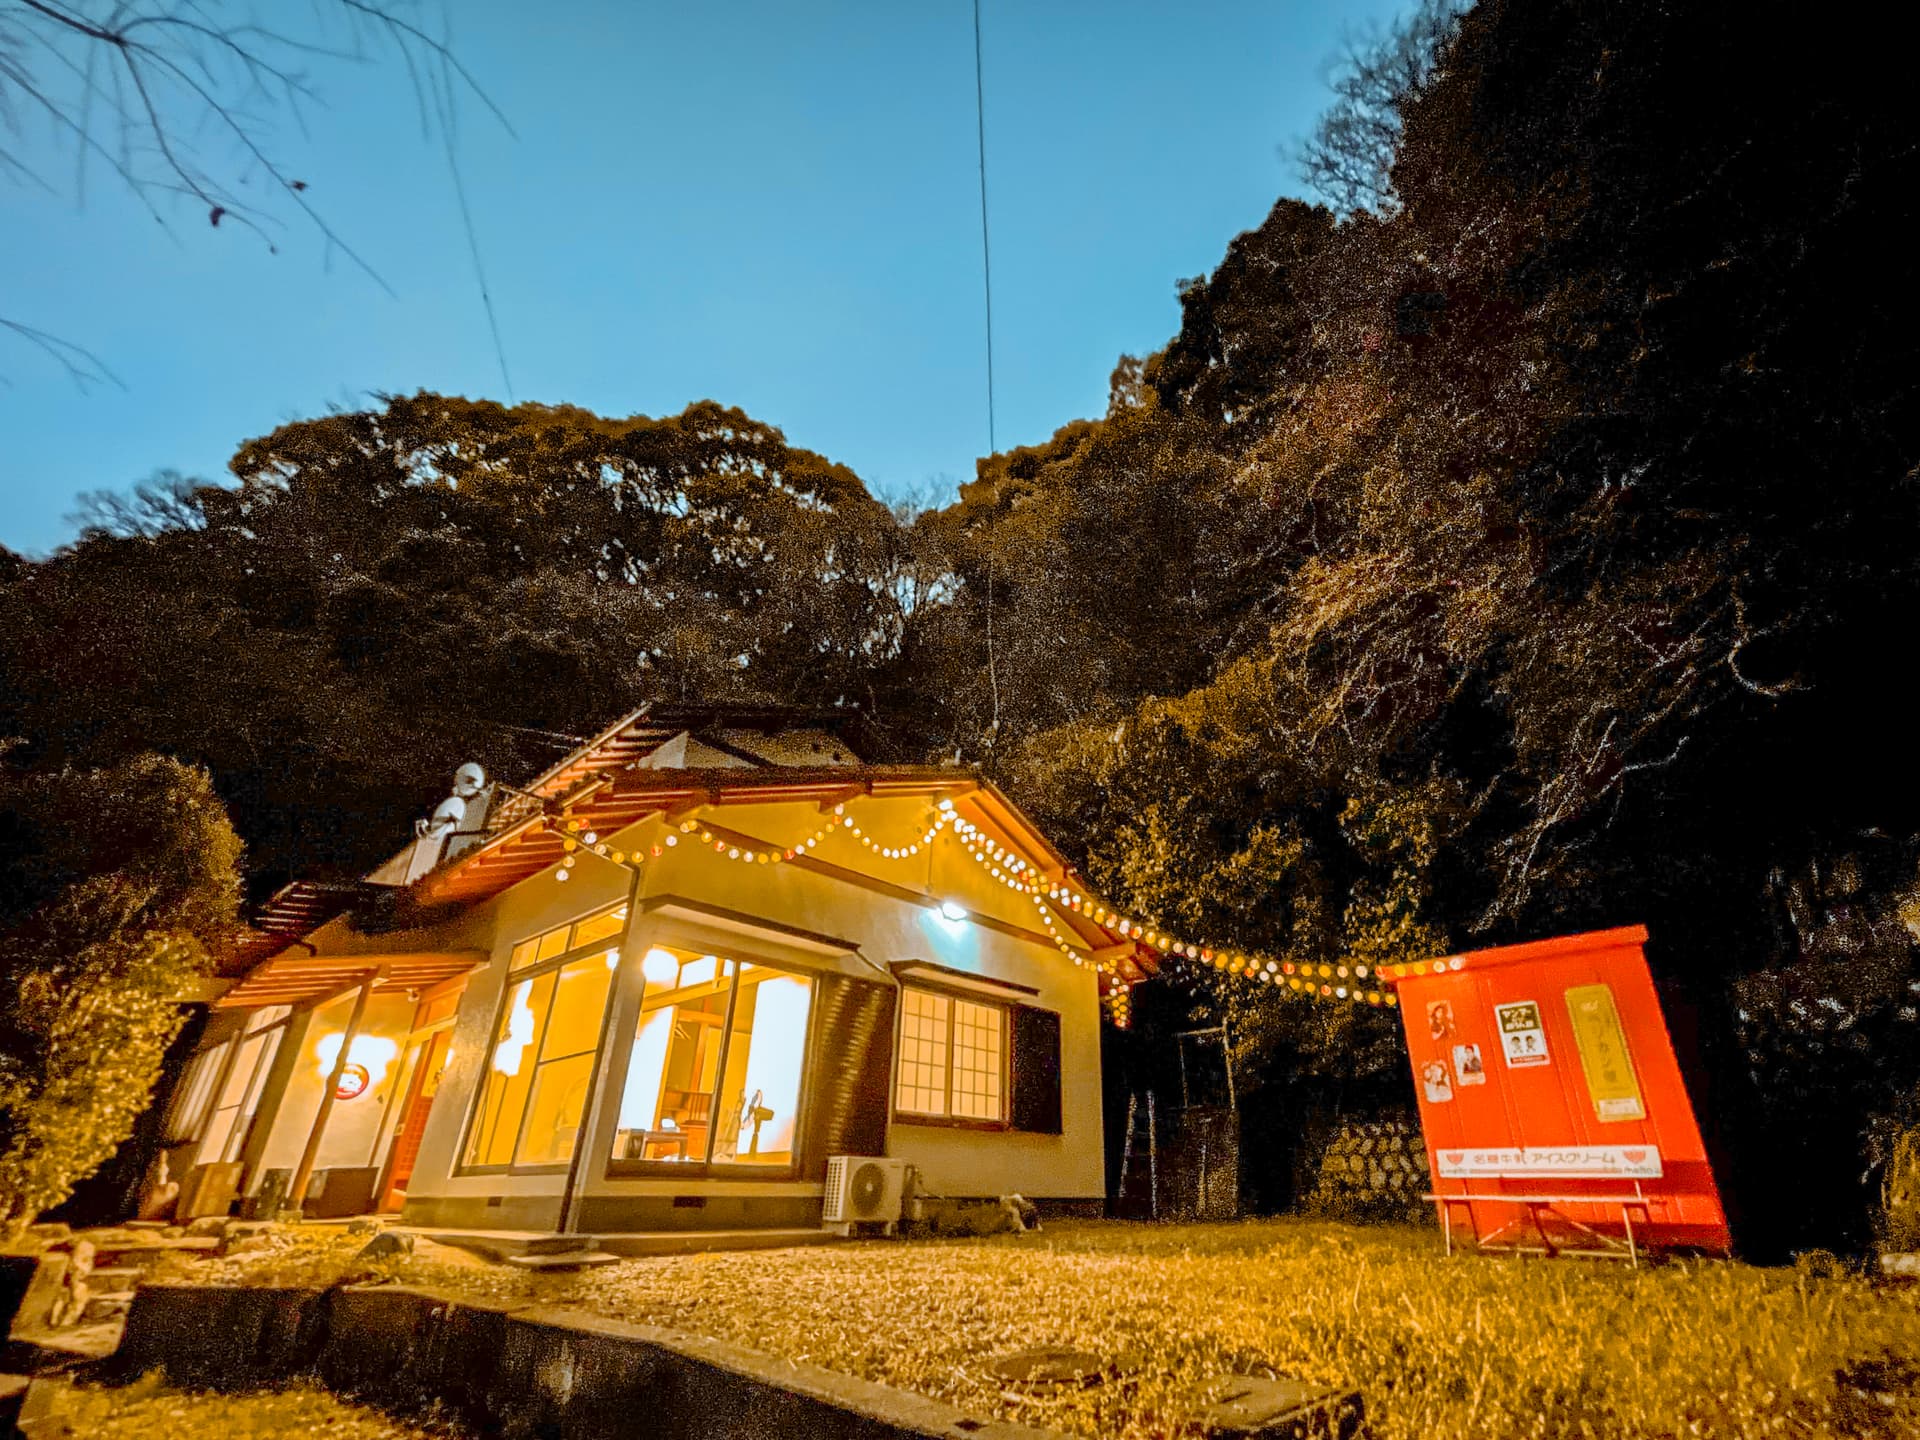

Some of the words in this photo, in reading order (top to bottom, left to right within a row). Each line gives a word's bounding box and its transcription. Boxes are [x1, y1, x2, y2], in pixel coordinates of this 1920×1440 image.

[1531, 1152, 1616, 1165] アイスクリーム
